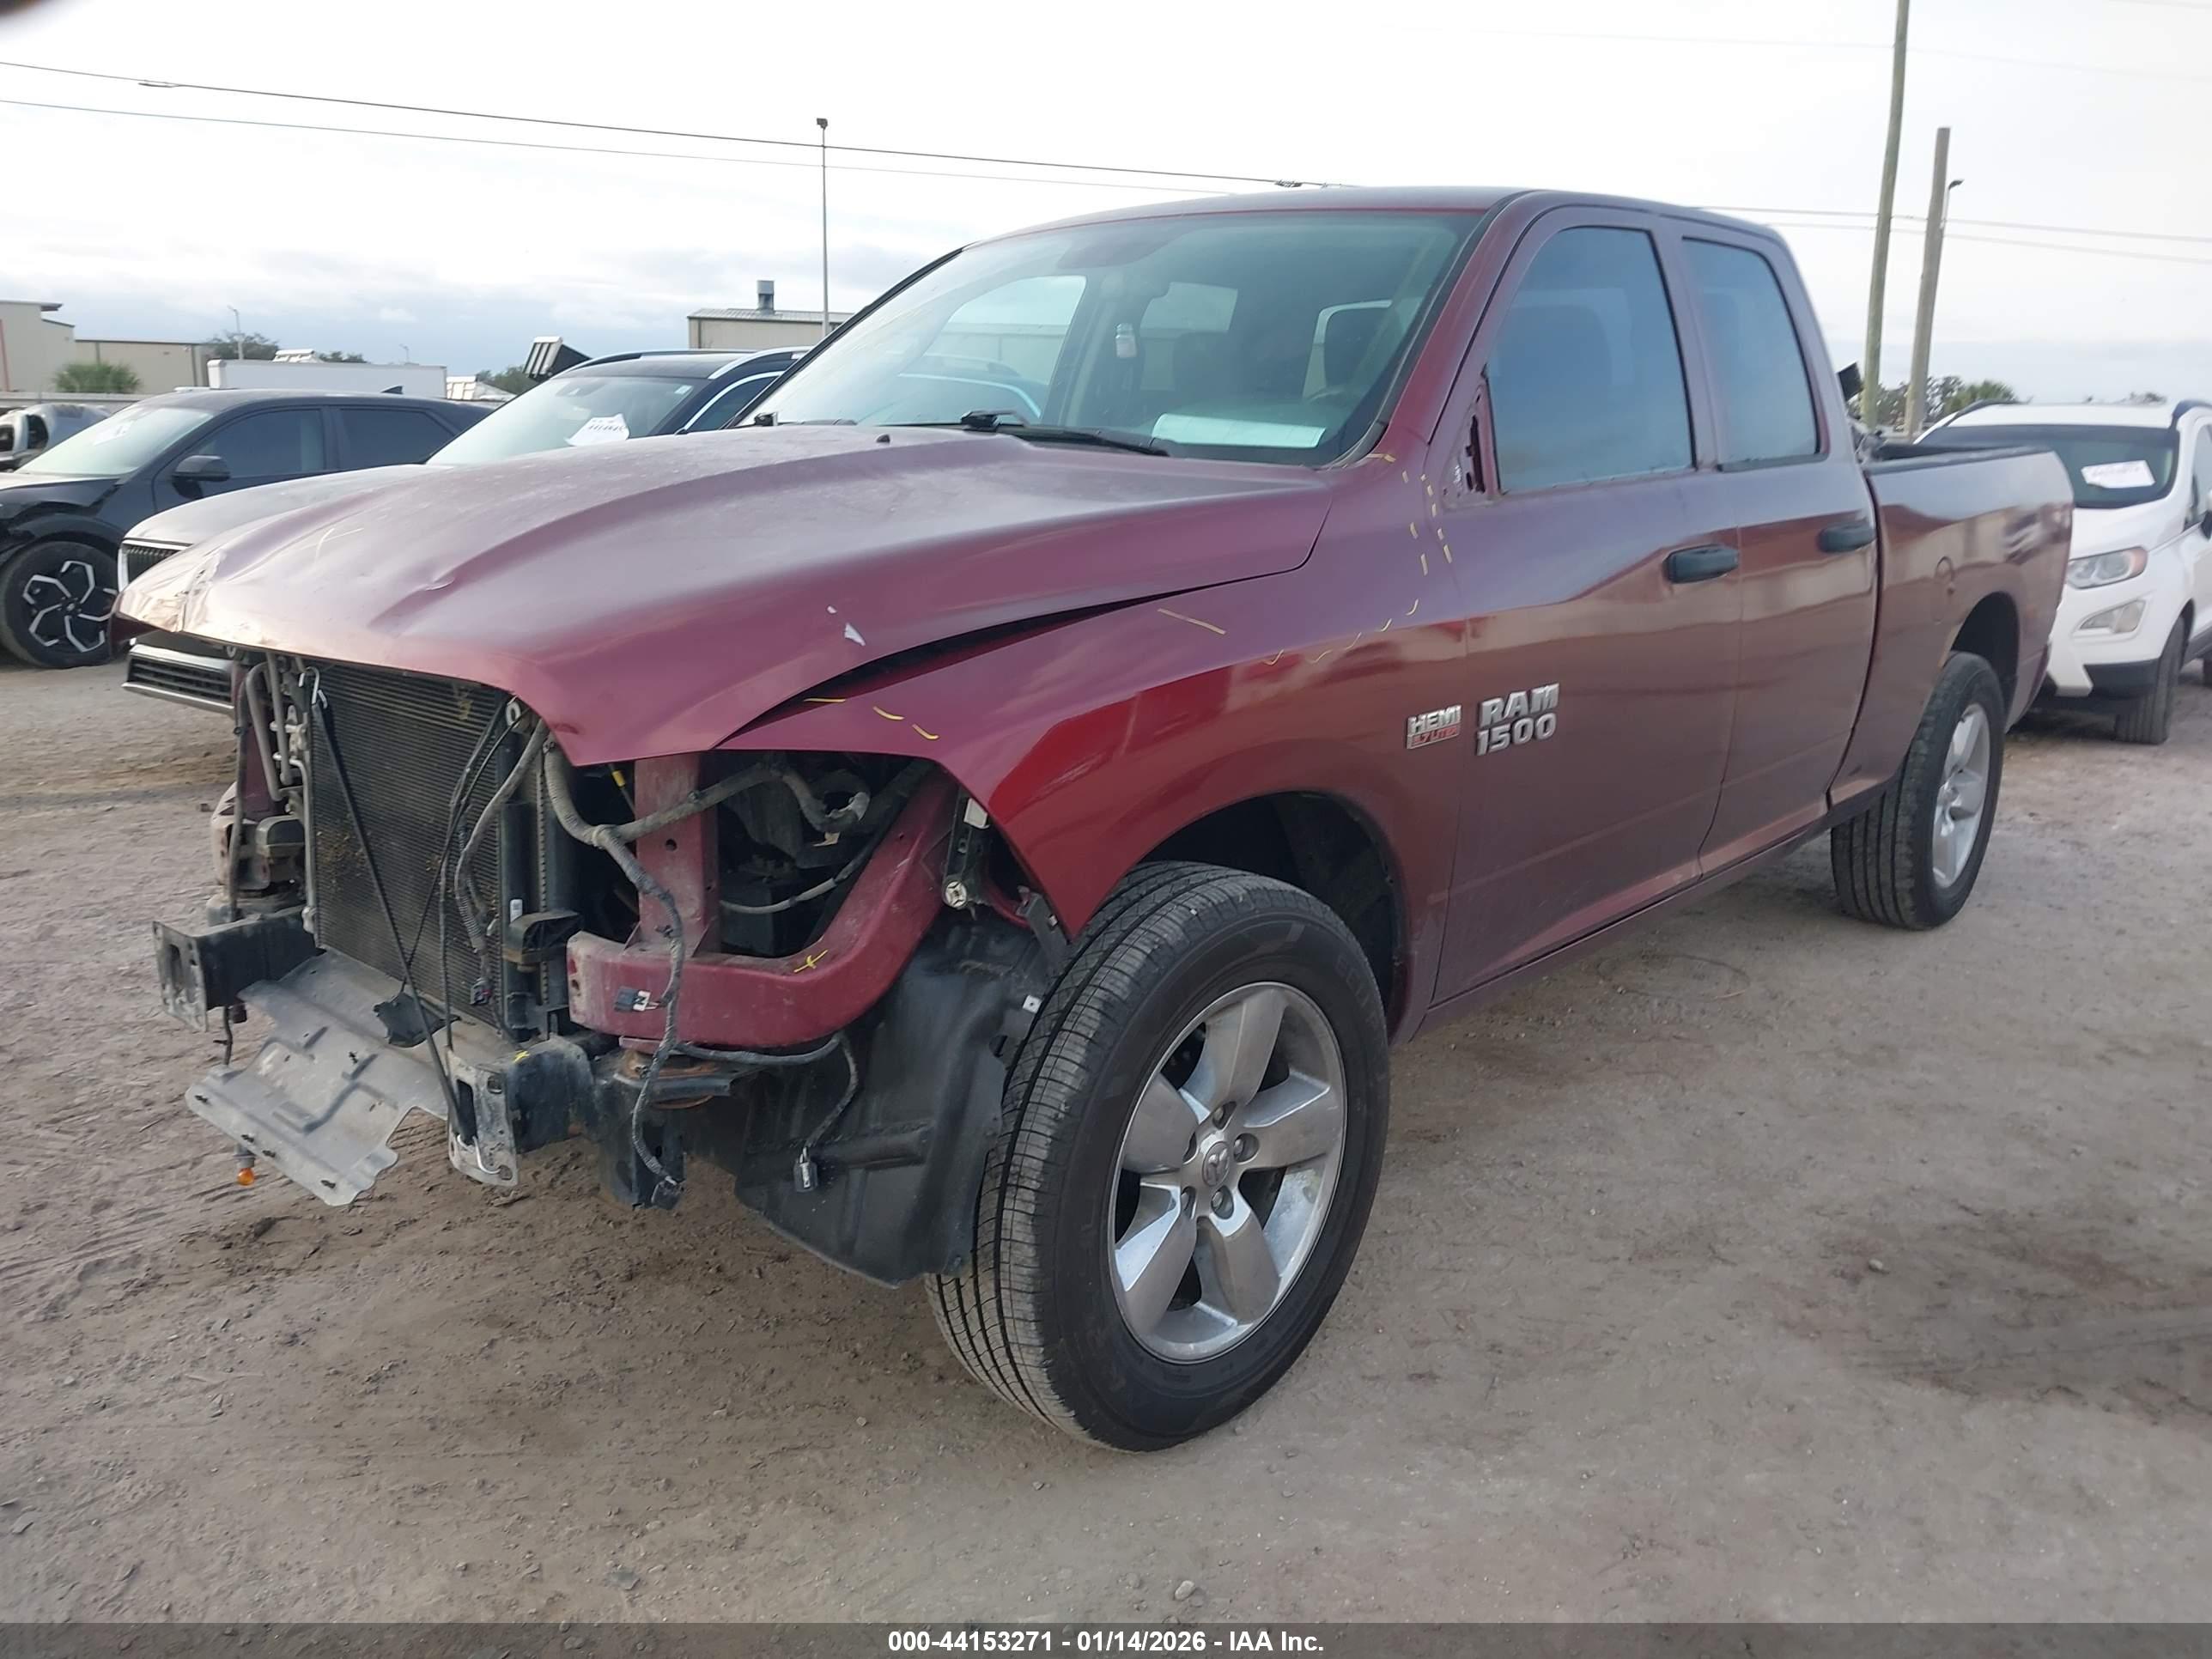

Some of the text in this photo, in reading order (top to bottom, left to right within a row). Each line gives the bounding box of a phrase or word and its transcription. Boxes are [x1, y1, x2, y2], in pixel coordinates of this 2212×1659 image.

[1407, 705, 1462, 736] HEMI
[1479, 683, 1559, 728] RAM
[1476, 713, 1557, 757] 1500
